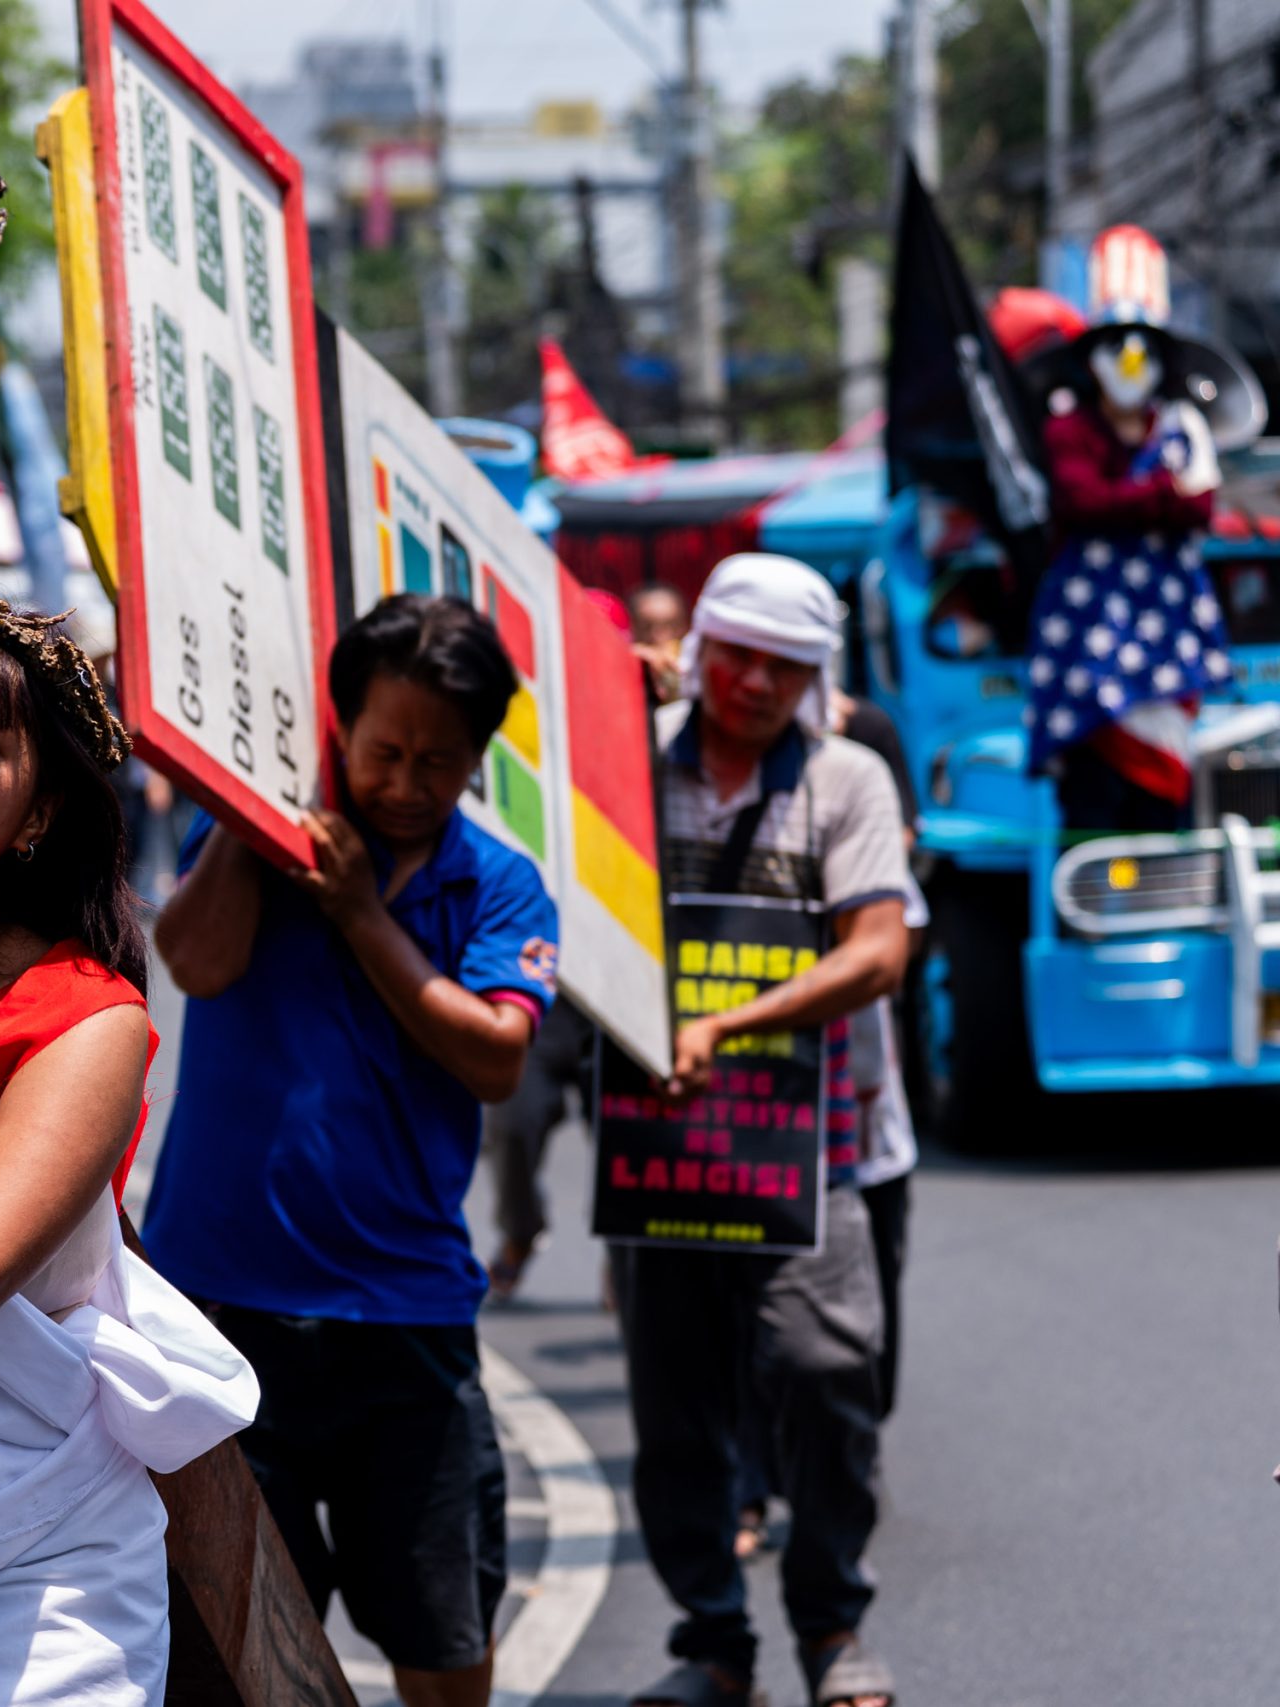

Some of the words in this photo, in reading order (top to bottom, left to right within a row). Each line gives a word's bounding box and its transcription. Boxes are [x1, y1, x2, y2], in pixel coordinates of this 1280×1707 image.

[179, 615, 202, 727] Gas
[223, 582, 255, 774] Diesel
[273, 688, 300, 808] LPG
